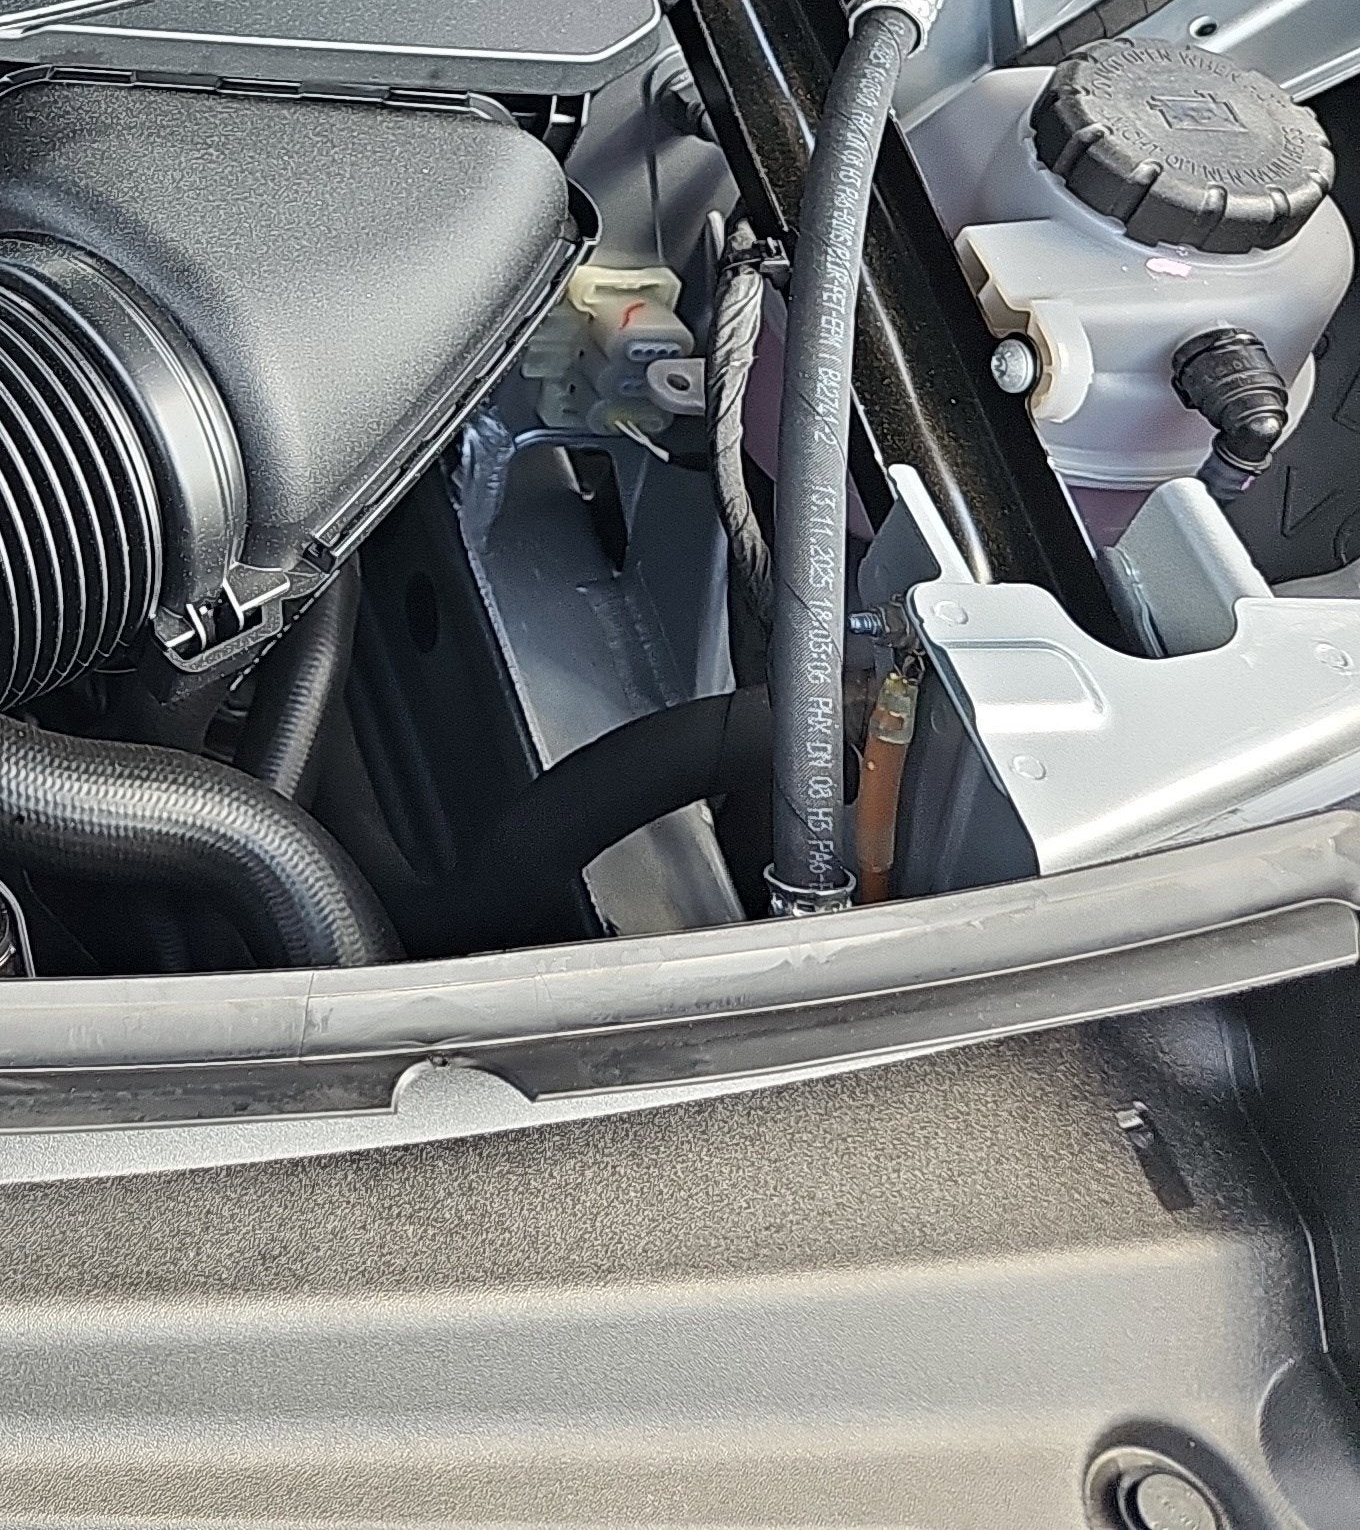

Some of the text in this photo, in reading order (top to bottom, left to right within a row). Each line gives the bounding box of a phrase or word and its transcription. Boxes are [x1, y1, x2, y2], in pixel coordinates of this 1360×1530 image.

[1122, 48, 1173, 64] OPEN
[1179, 51, 1240, 82] WHEN
[808, 482, 837, 592] 13.11.2025
[806, 696, 833, 734] PHX
[805, 741, 833, 768] DN
